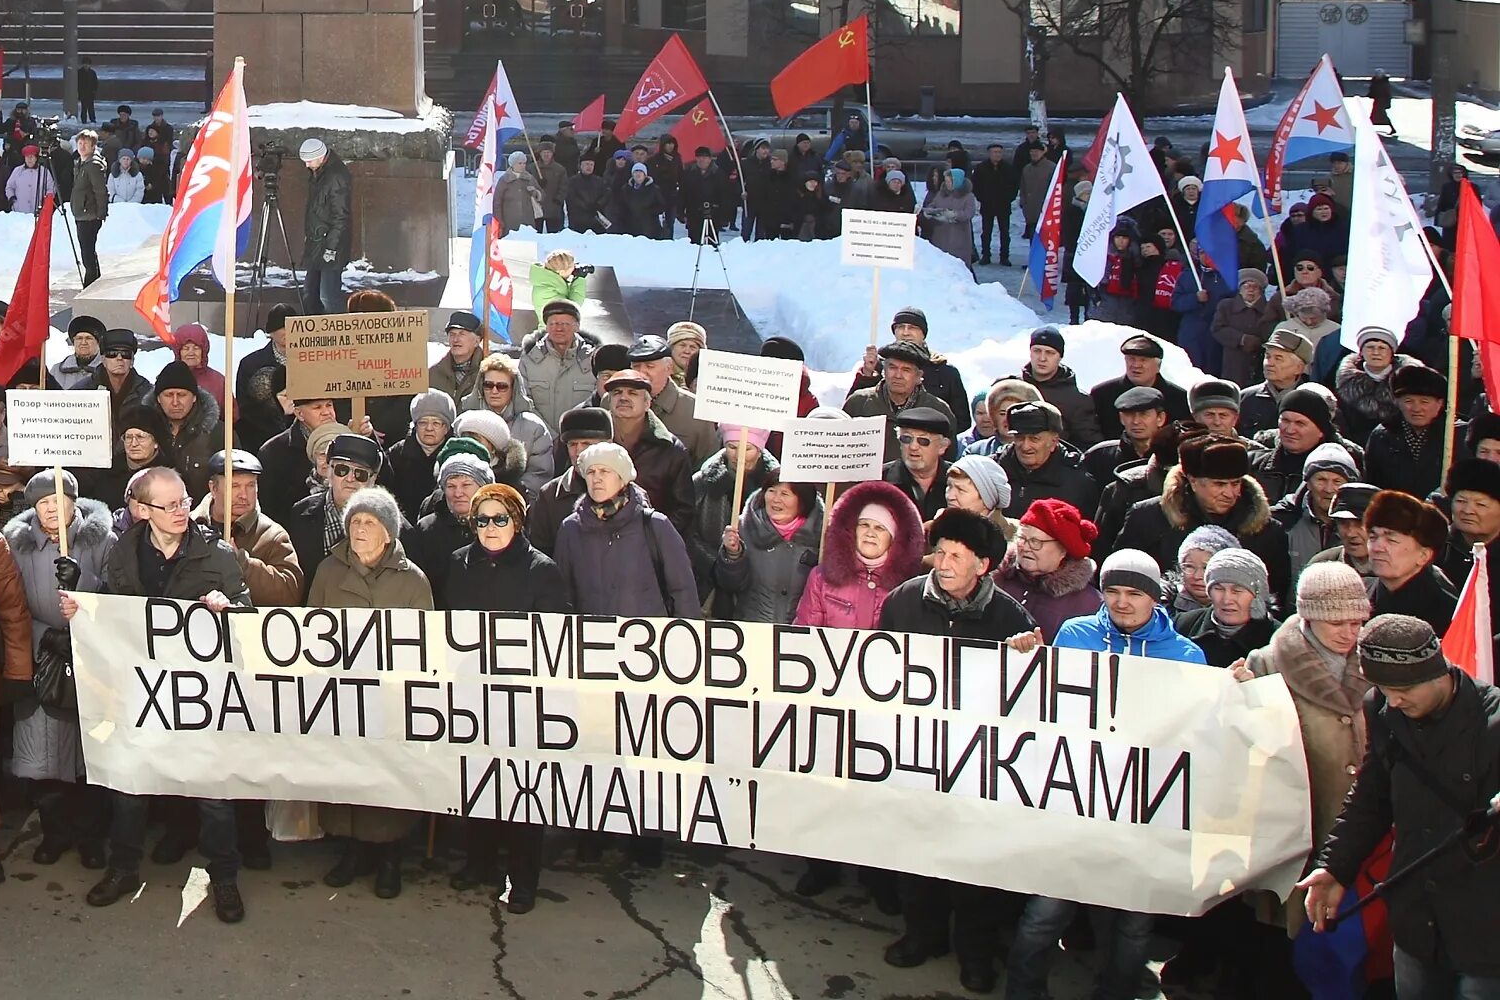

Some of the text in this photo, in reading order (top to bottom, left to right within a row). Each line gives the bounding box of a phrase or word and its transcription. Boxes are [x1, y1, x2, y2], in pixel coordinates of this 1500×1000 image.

[290, 318, 316, 333] МО
[356, 333, 394, 345] ЧЕТКАРЕВ
[298, 348, 358, 362] ВЕРНИТЕ
[357, 358, 392, 370] НАШИ
[707, 361, 794, 378] РУКОВОДСТВО УДМУРТИИ
[325, 382, 342, 392] ДНТ
[383, 381, 396, 389] НАС
[399, 380, 411, 389] 25
[706, 385, 790, 402] ПАМЯТНИКИ ИСТОРИИ
[13, 399, 41, 409] Позор
[21, 417, 93, 425] уничтожающим
[13, 432, 103, 442] памятники истории
[851, 429, 881, 437] ВЛАСТИ
[43, 448, 82, 456] Ижевска
[145, 598, 1121, 732] РОГОЗИН, ЧЕМЕЗОВ, БУСЫГИН!
[135, 666, 1191, 831] ХВАТИТ БЫТЬ МОГИЛЬЩИКАМИ
